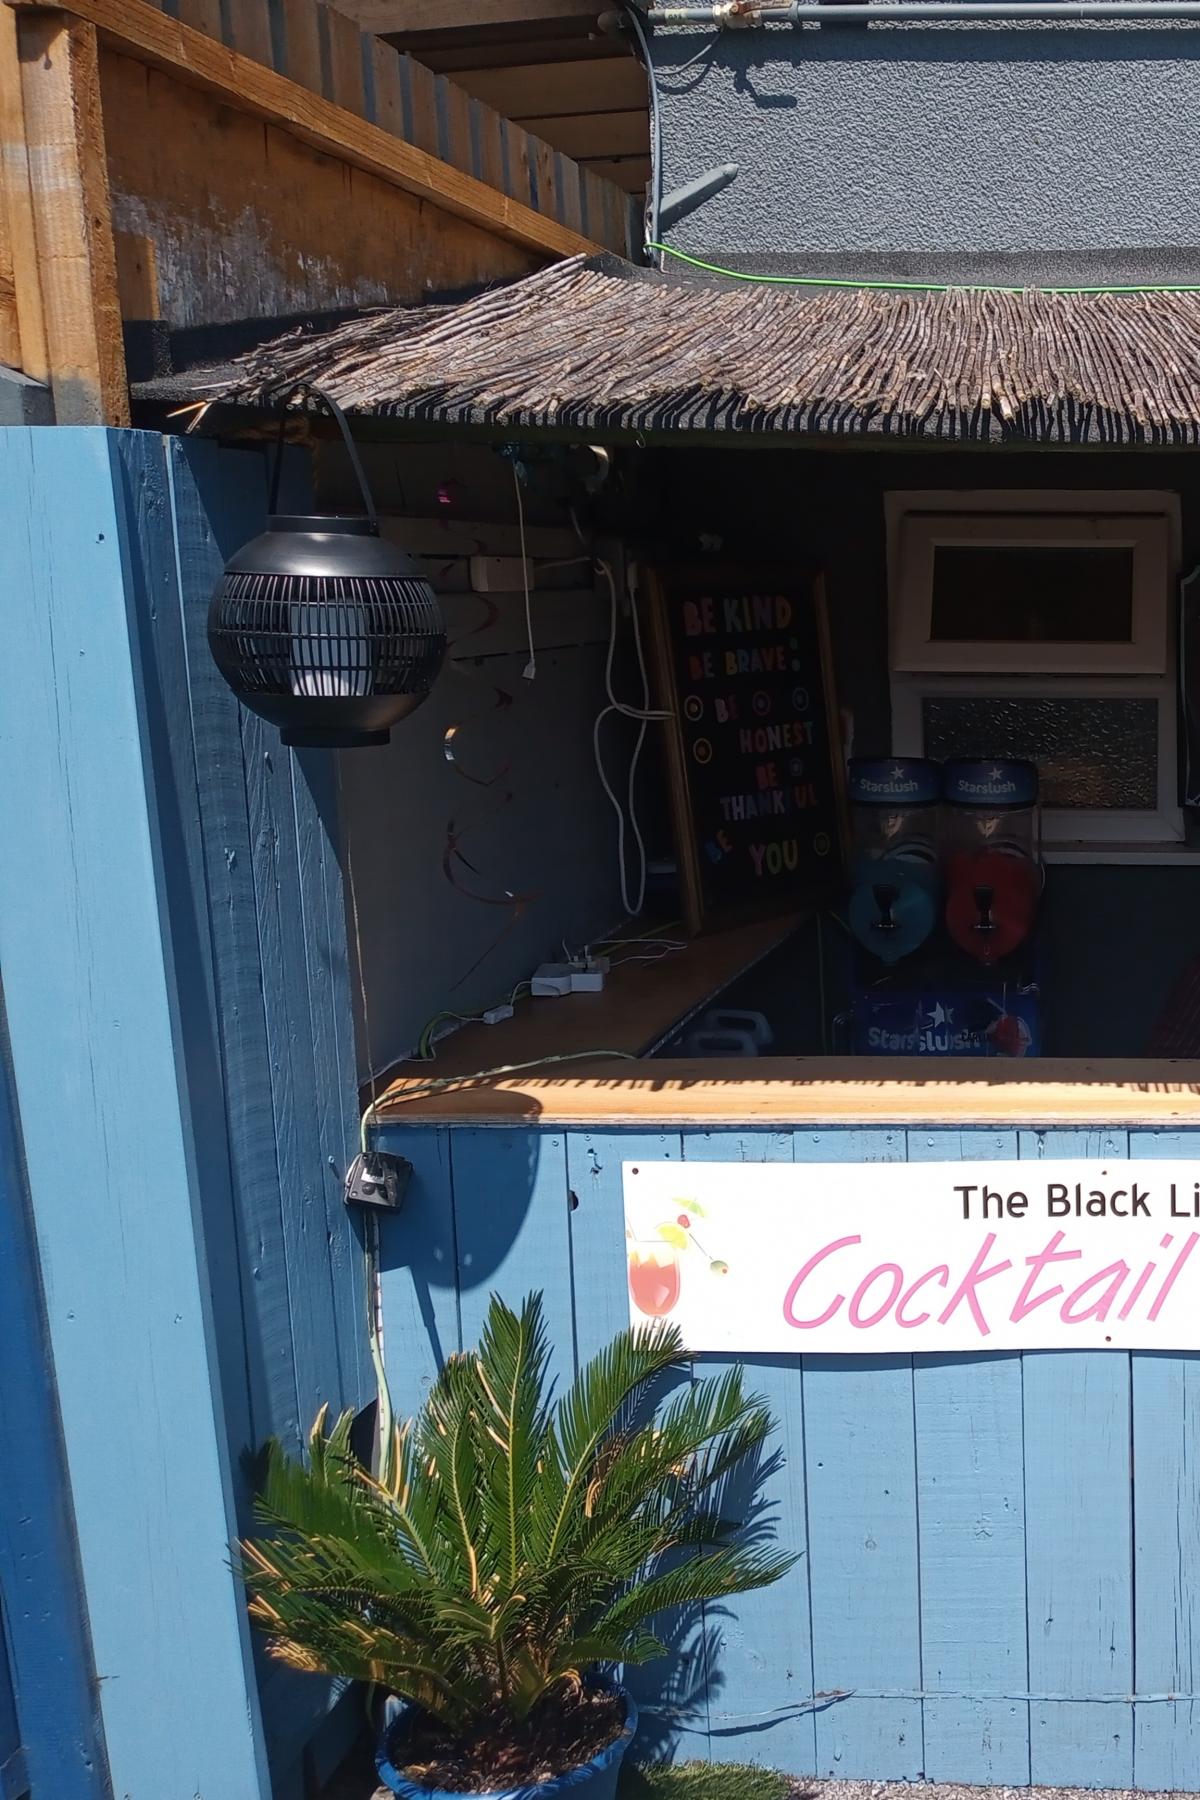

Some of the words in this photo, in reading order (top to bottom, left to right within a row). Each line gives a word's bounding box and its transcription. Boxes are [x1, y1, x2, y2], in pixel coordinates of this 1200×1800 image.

[682, 597, 716, 636] BE
[723, 594, 792, 632] KIND
[688, 652, 714, 680] BE
[714, 694, 739, 723] BE
[739, 720, 813, 754] HONEST
[755, 761, 778, 791] BE
[859, 777, 918, 794] Starslush
[958, 779, 1016, 795] Starslush
[748, 838, 799, 876] YOU
[953, 1185, 1029, 1219] The
[1047, 1183, 1151, 1217] Black
[782, 1230, 1200, 1336] Cocktail
